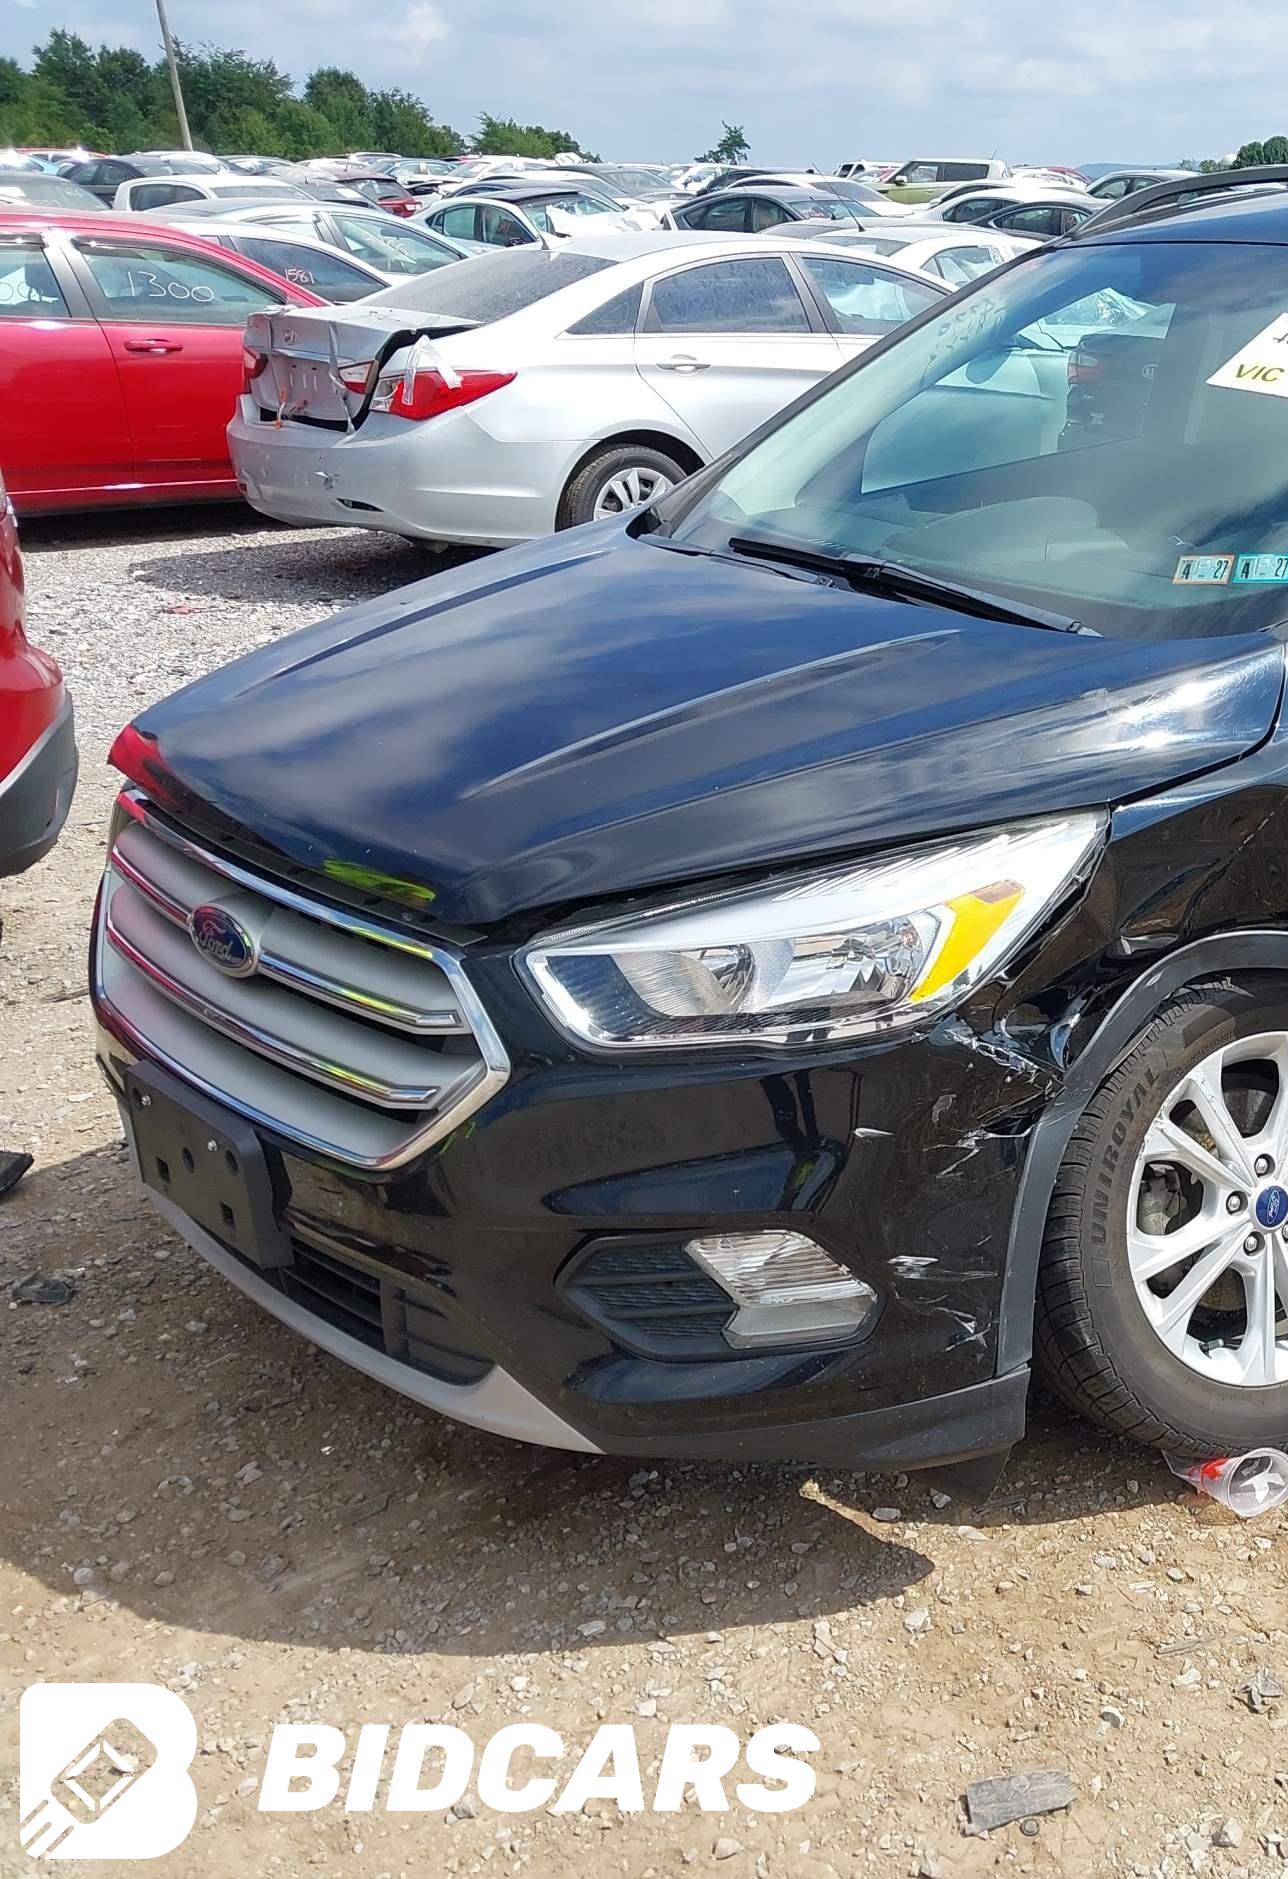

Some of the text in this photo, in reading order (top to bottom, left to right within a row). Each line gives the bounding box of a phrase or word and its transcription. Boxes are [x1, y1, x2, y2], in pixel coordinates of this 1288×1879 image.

[127, 271, 214, 302] 1300
[285, 268, 315, 284] 1581
[1235, 363, 1285, 383] VIC
[1181, 560, 1229, 580] 4 27
[1240, 558, 1288, 579] 4 27
[198, 920, 234, 960] Ford
[1091, 1067, 1160, 1247] UNIROYAL
